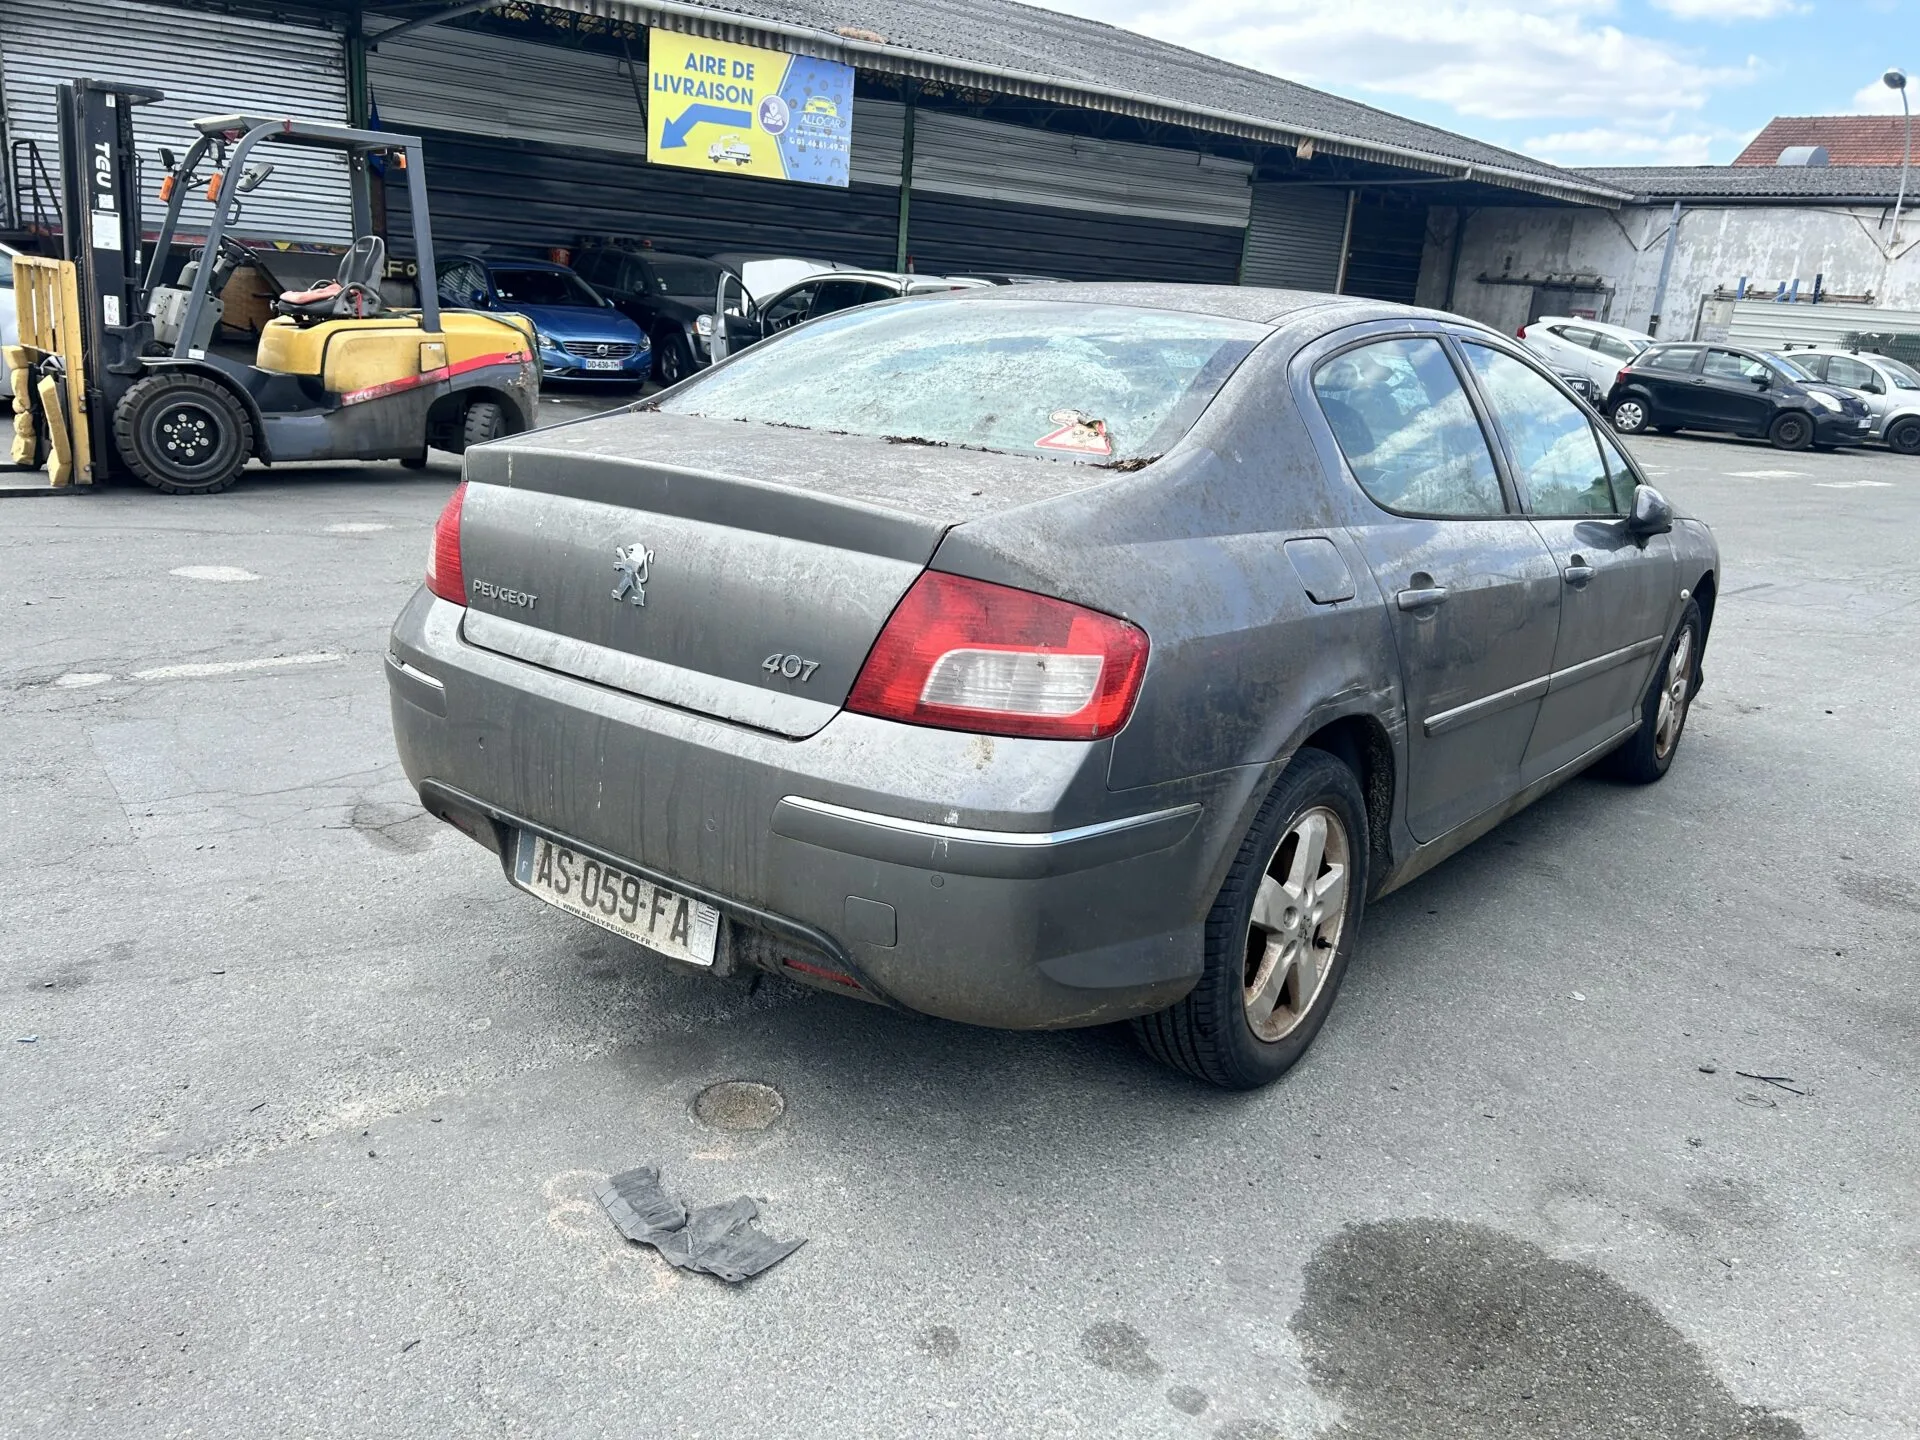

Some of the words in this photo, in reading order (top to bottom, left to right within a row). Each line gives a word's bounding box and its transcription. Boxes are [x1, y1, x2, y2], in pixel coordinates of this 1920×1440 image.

[685, 52, 726, 76] AIRE
[732, 62, 755, 81] DE
[654, 72, 753, 106] LIVRAISON
[800, 114, 842, 128] ALLOCAR
[472, 579, 538, 610] PEUGEOT
[761, 653, 821, 683] 407
[537, 842, 691, 947] AS-059-FA
